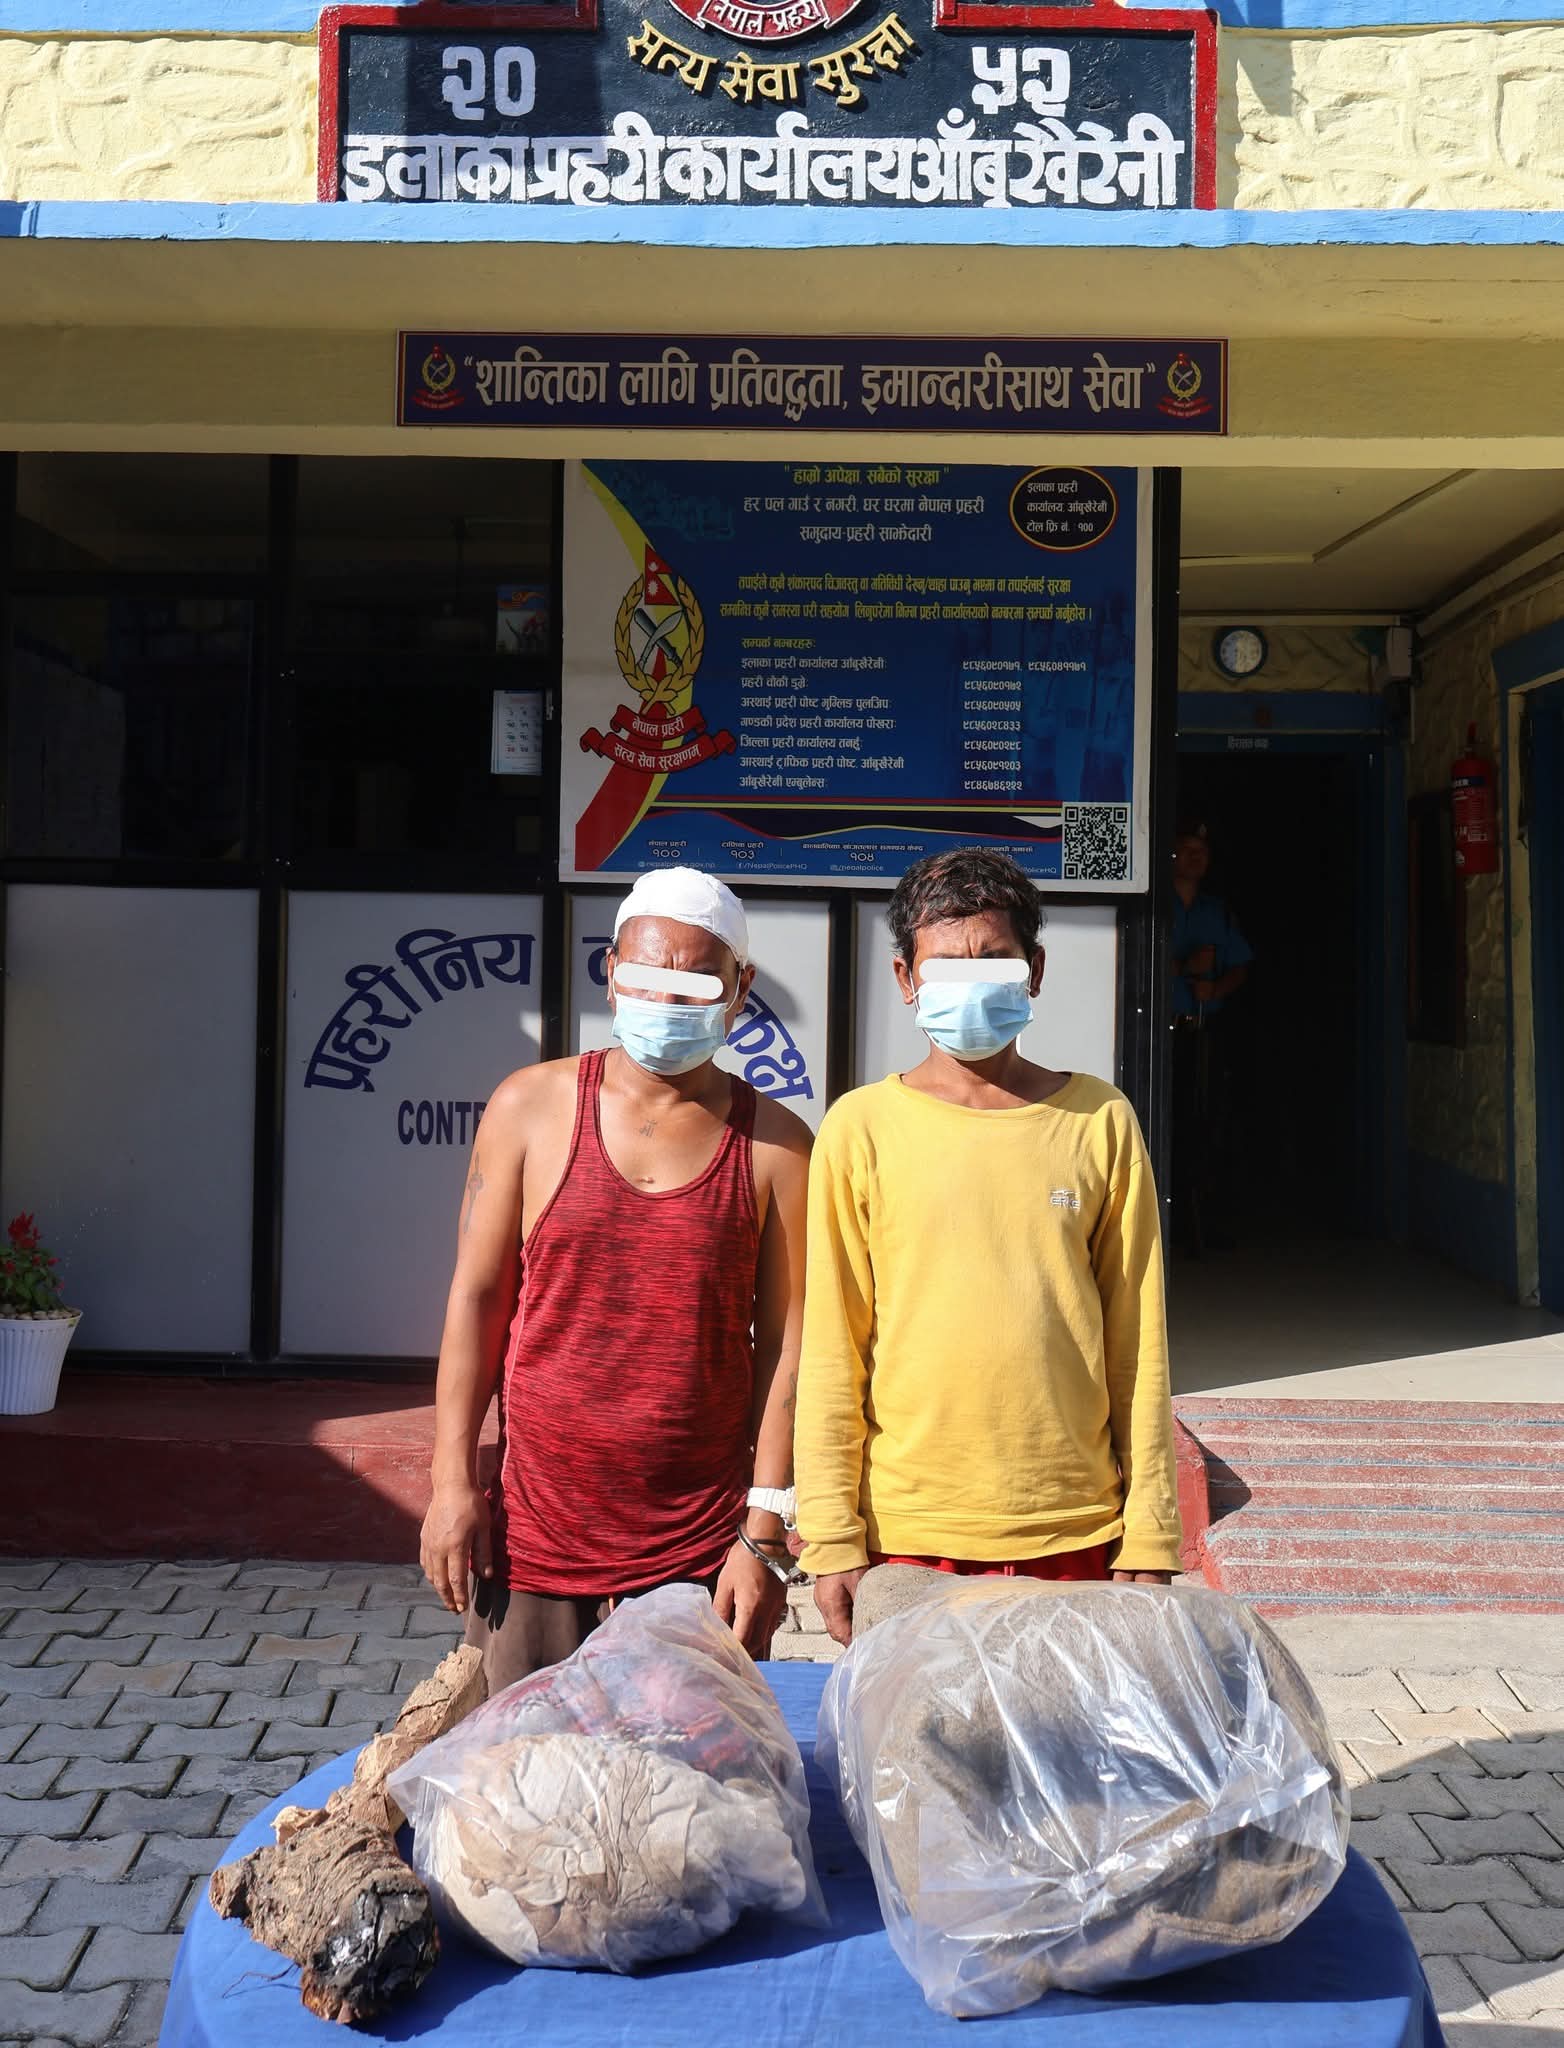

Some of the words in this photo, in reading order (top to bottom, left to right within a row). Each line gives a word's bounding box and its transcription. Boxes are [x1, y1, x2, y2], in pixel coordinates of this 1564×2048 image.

[627, 19, 719, 93] सत्य
[720, 52, 800, 103] सेवा
[809, 12, 916, 105] सुरक्षा
[442, 46, 535, 120] २०
[971, 47, 1070, 117] ५२
[618, 346, 699, 407] लागि
[861, 351, 1072, 415] इमान्दारीसाथ
[794, 466, 820, 485] हाम्रो
[906, 467, 940, 489] सुरक्षा
[1027, 482, 1055, 494] इलाका
[1057, 480, 1078, 494] प्रहरी
[743, 497, 761, 512] हर
[765, 497, 785, 512] पल
[813, 498, 823, 513] र
[863, 498, 881, 513] घर
[884, 498, 915, 513] घरमा
[918, 495, 952, 513] नेपाल
[956, 496, 985, 515] प्रहरी
[879, 522, 933, 543] साझेदारी
[1026, 519, 1044, 533] टोल
[1078, 522, 1094, 533] १००
[1047, 579, 1072, 596] सुरक्षा
[919, 601, 941, 620] प्रहरी
[741, 657, 771, 670] इलाका
[774, 655, 797, 669] प्रहरी
[799, 656, 839, 670] कार्यालय
[741, 675, 764, 689] प्रहरी
[774, 694, 797, 709] प्रहरी
[631, 717, 659, 736] नेपाल
[661, 716, 685, 738] प्रहरी
[775, 714, 798, 729] प्रदेश
[800, 715, 822, 729] प्रहरी
[824, 716, 865, 729] कार्यालय
[739, 734, 770, 748] जिल्ला
[772, 735, 795, 749] प्रहरी
[796, 736, 837, 749] कार्यालय
[614, 742, 636, 763] सत्य
[637, 751, 656, 769] सेवा
[658, 744, 702, 771] सुरक्षणम्
[811, 755, 834, 770] प्रहरी
[652, 848, 681, 858] १००
[730, 849, 755, 859] १०३
[850, 852, 875, 862] १०४
[304, 964, 423, 1093] प्रहरी
